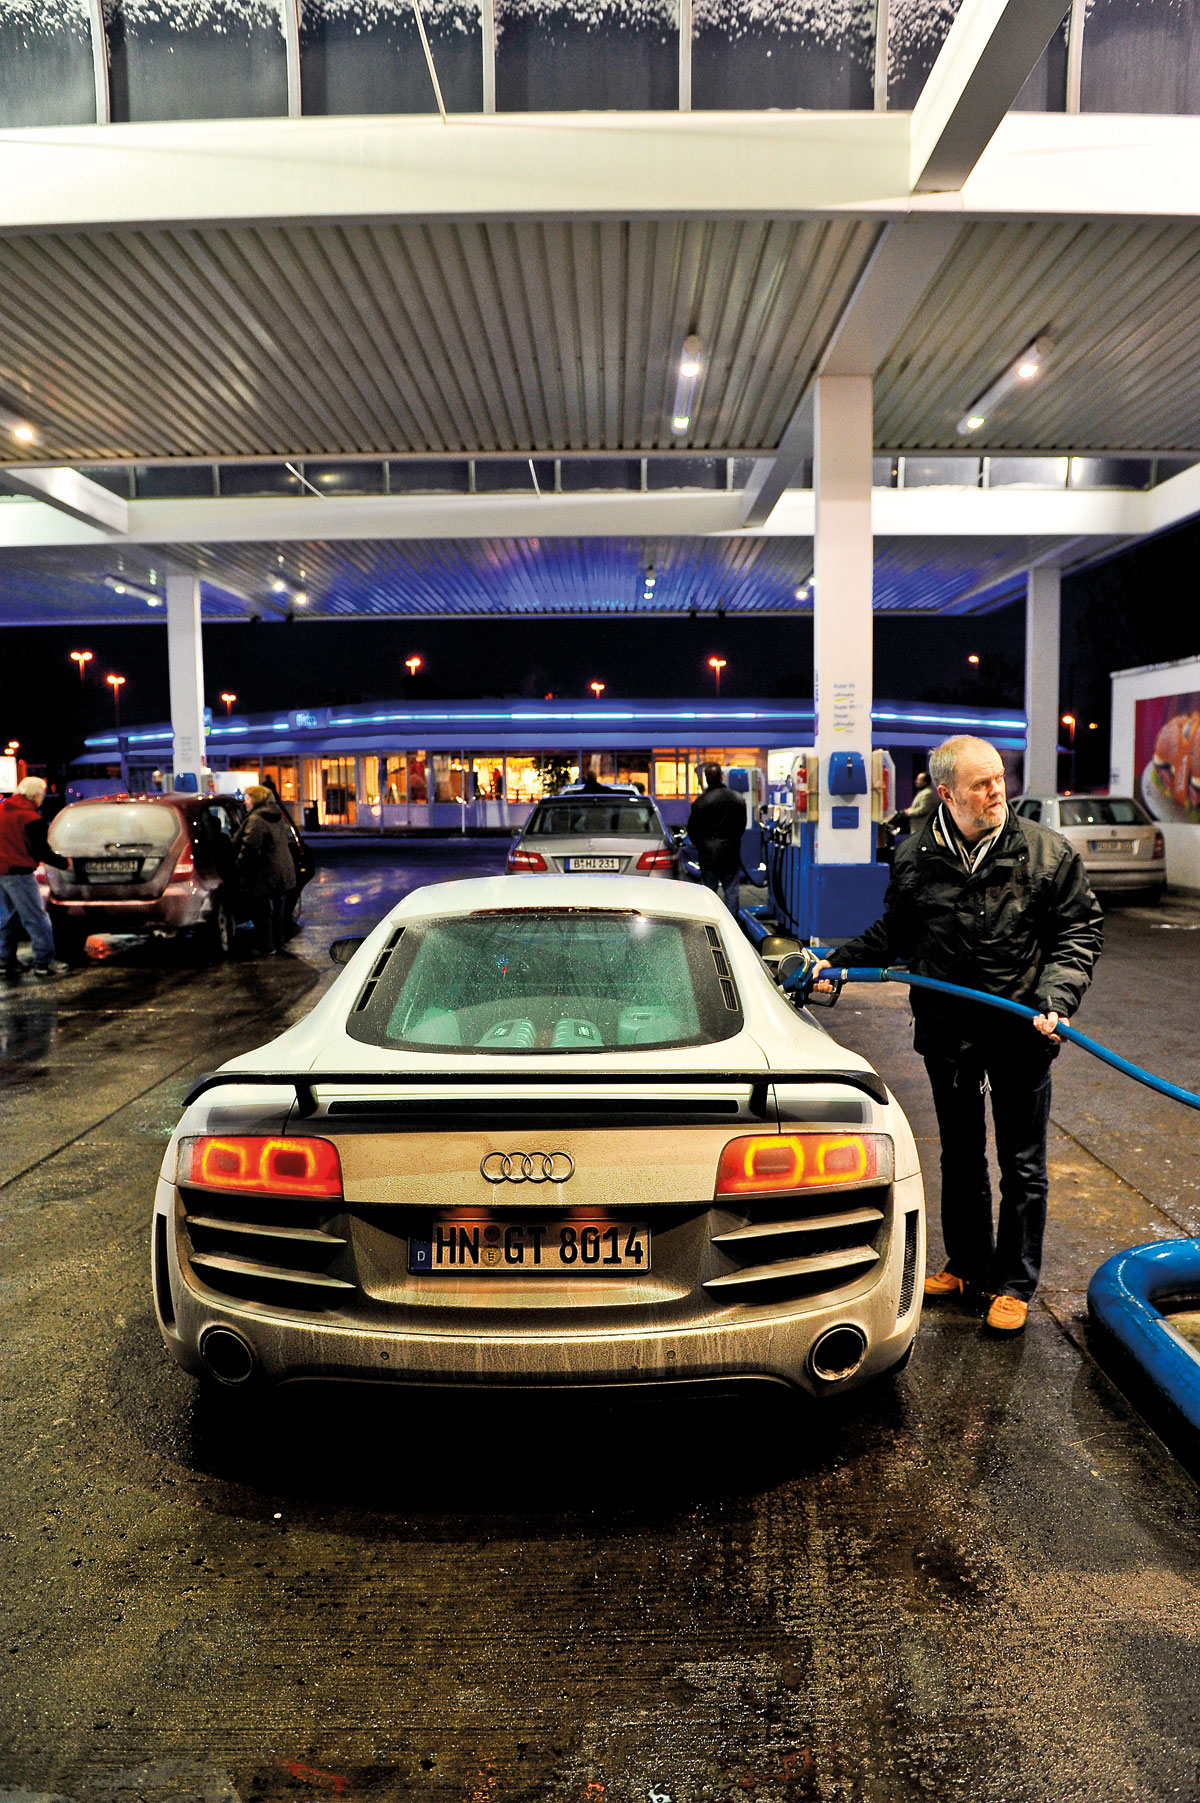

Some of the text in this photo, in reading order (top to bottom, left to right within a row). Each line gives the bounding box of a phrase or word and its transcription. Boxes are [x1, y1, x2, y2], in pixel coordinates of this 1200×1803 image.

[574, 860, 614, 868] B HI 231
[417, 1226, 644, 1264] D HN GT 8014
